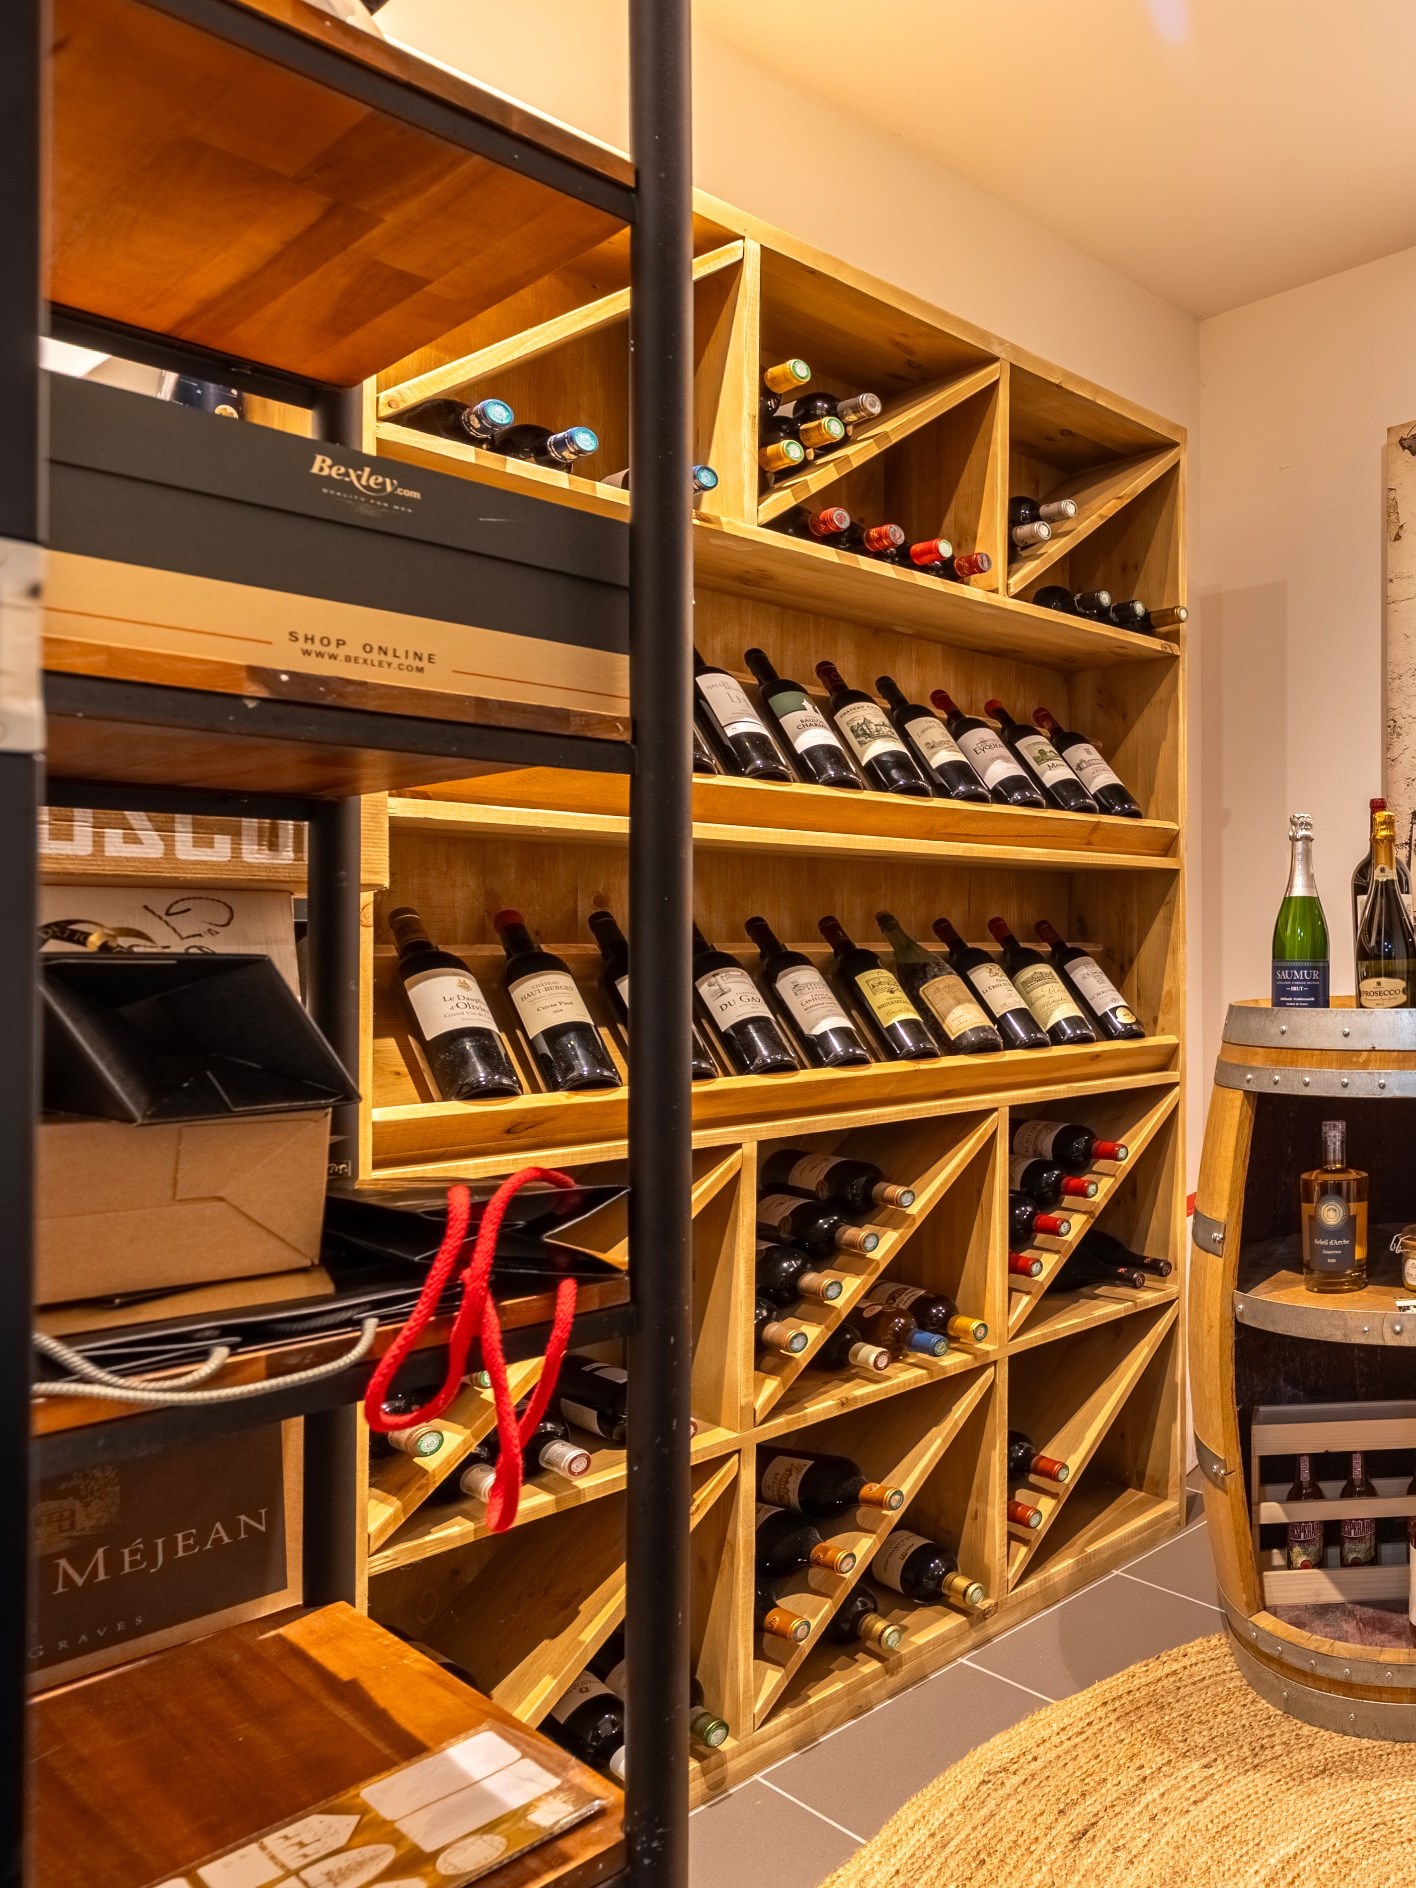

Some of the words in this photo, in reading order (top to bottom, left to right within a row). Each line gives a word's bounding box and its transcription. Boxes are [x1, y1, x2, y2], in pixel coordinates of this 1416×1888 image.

[309, 453, 421, 500] Bexley.com
[288, 631, 348, 650] SHOP
[362, 643, 437, 665] ONLINE
[300, 647, 425, 674] WWW.BEXLEY.COM
[1276, 969, 1320, 980] SAUMUR
[1361, 988, 1401, 998] PROSECCO
[52, 1508, 268, 1596] MÉJEAN
[28, 1615, 143, 1660] GRAVES
